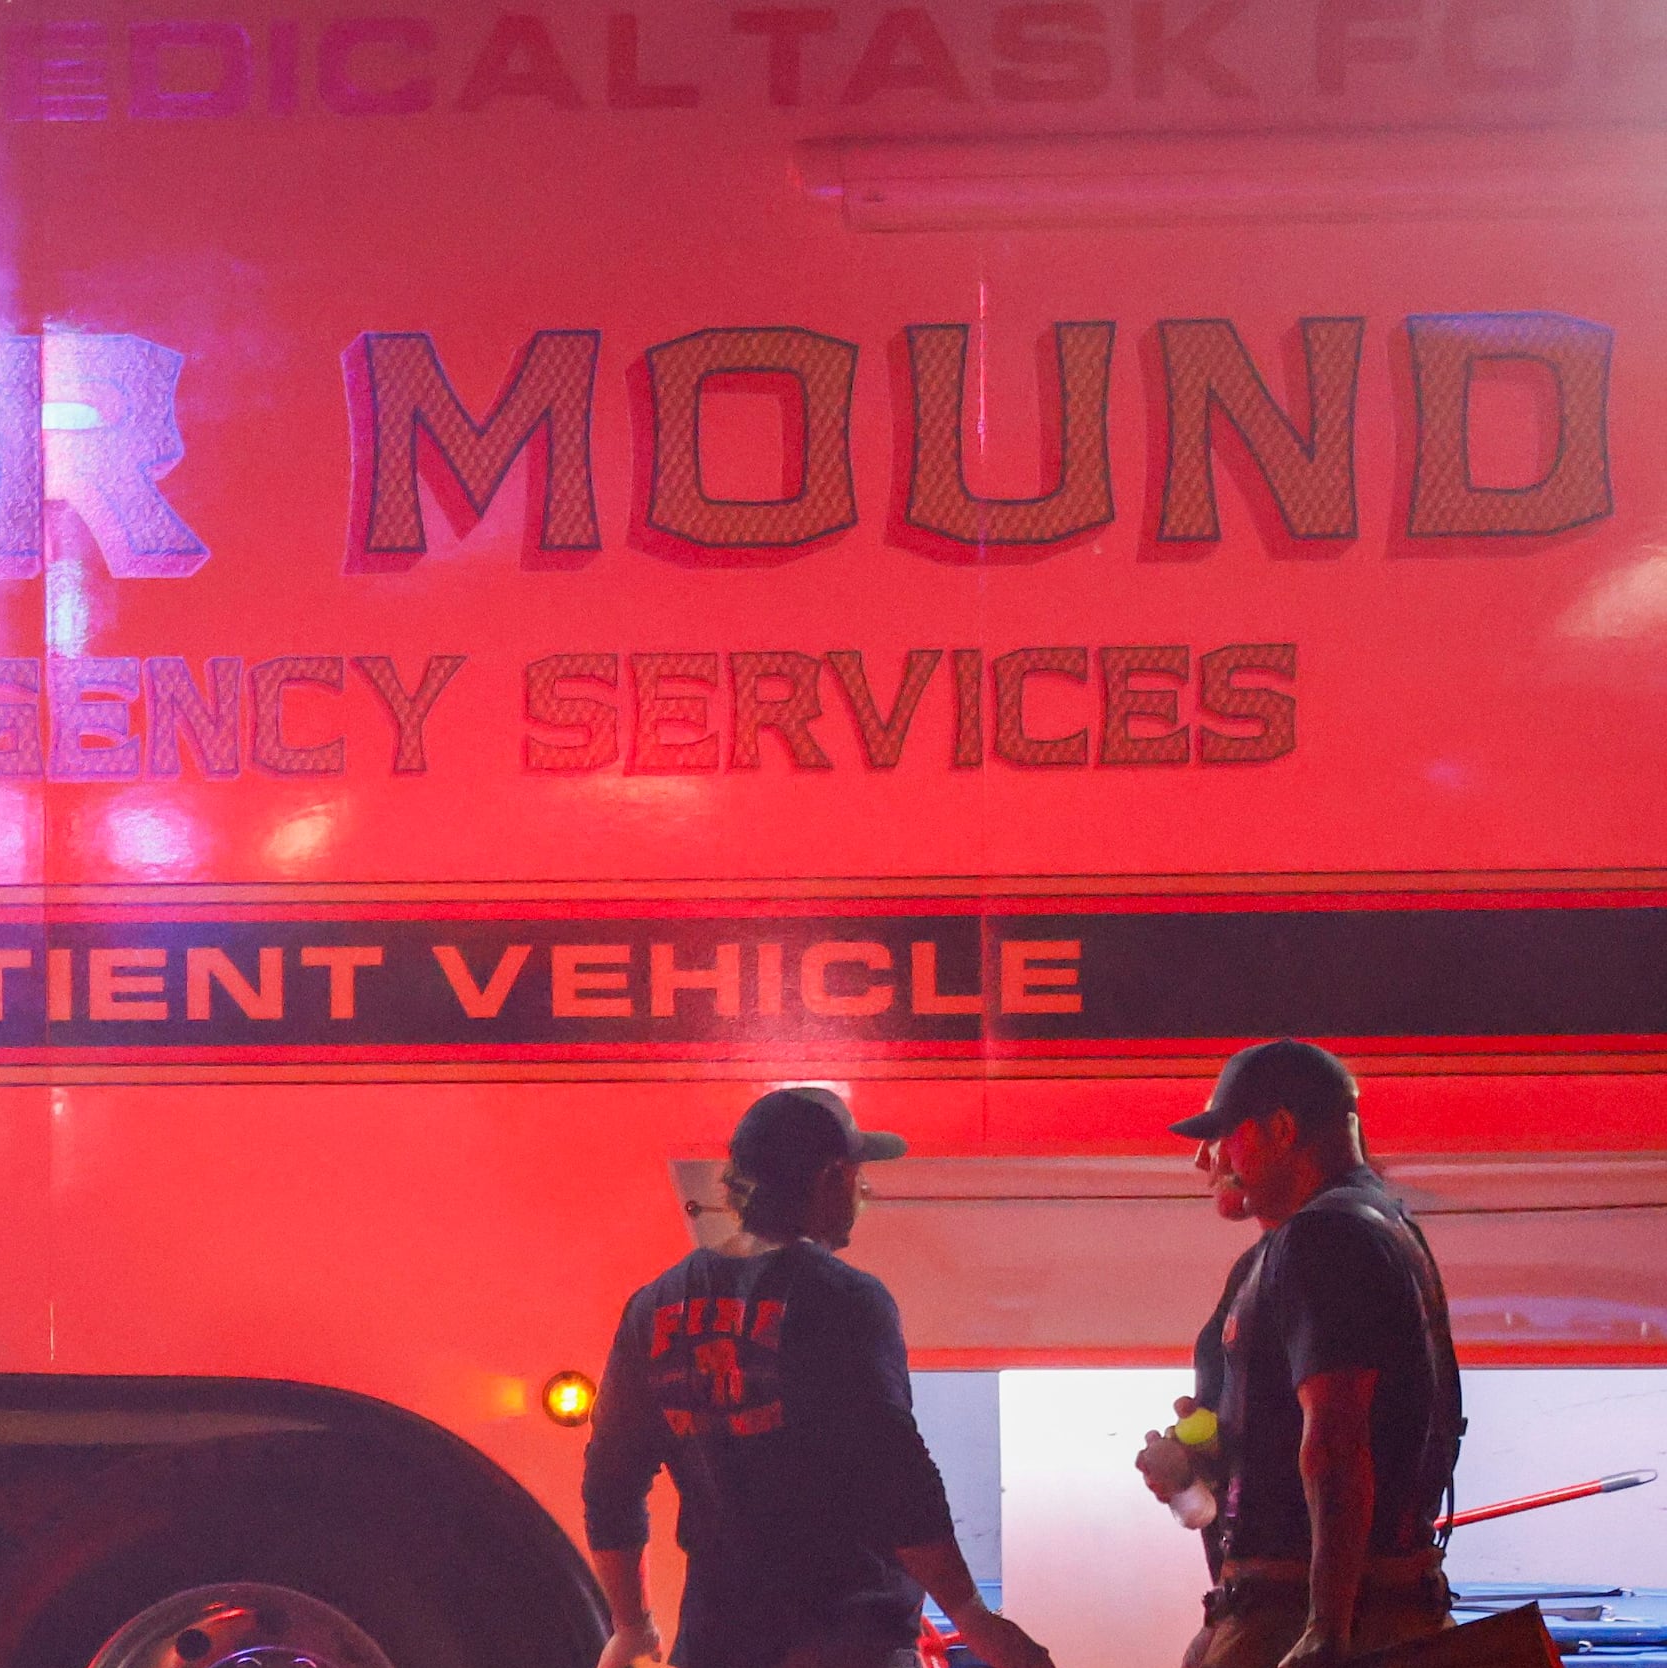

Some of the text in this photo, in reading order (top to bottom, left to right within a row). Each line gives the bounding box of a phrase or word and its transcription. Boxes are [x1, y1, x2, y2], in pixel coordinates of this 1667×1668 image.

[725, 0, 1259, 108] TASK
[341, 311, 1616, 573] MOUND
[523, 641, 1299, 778] SERVICES
[431, 938, 1084, 1019] VEHICLE
